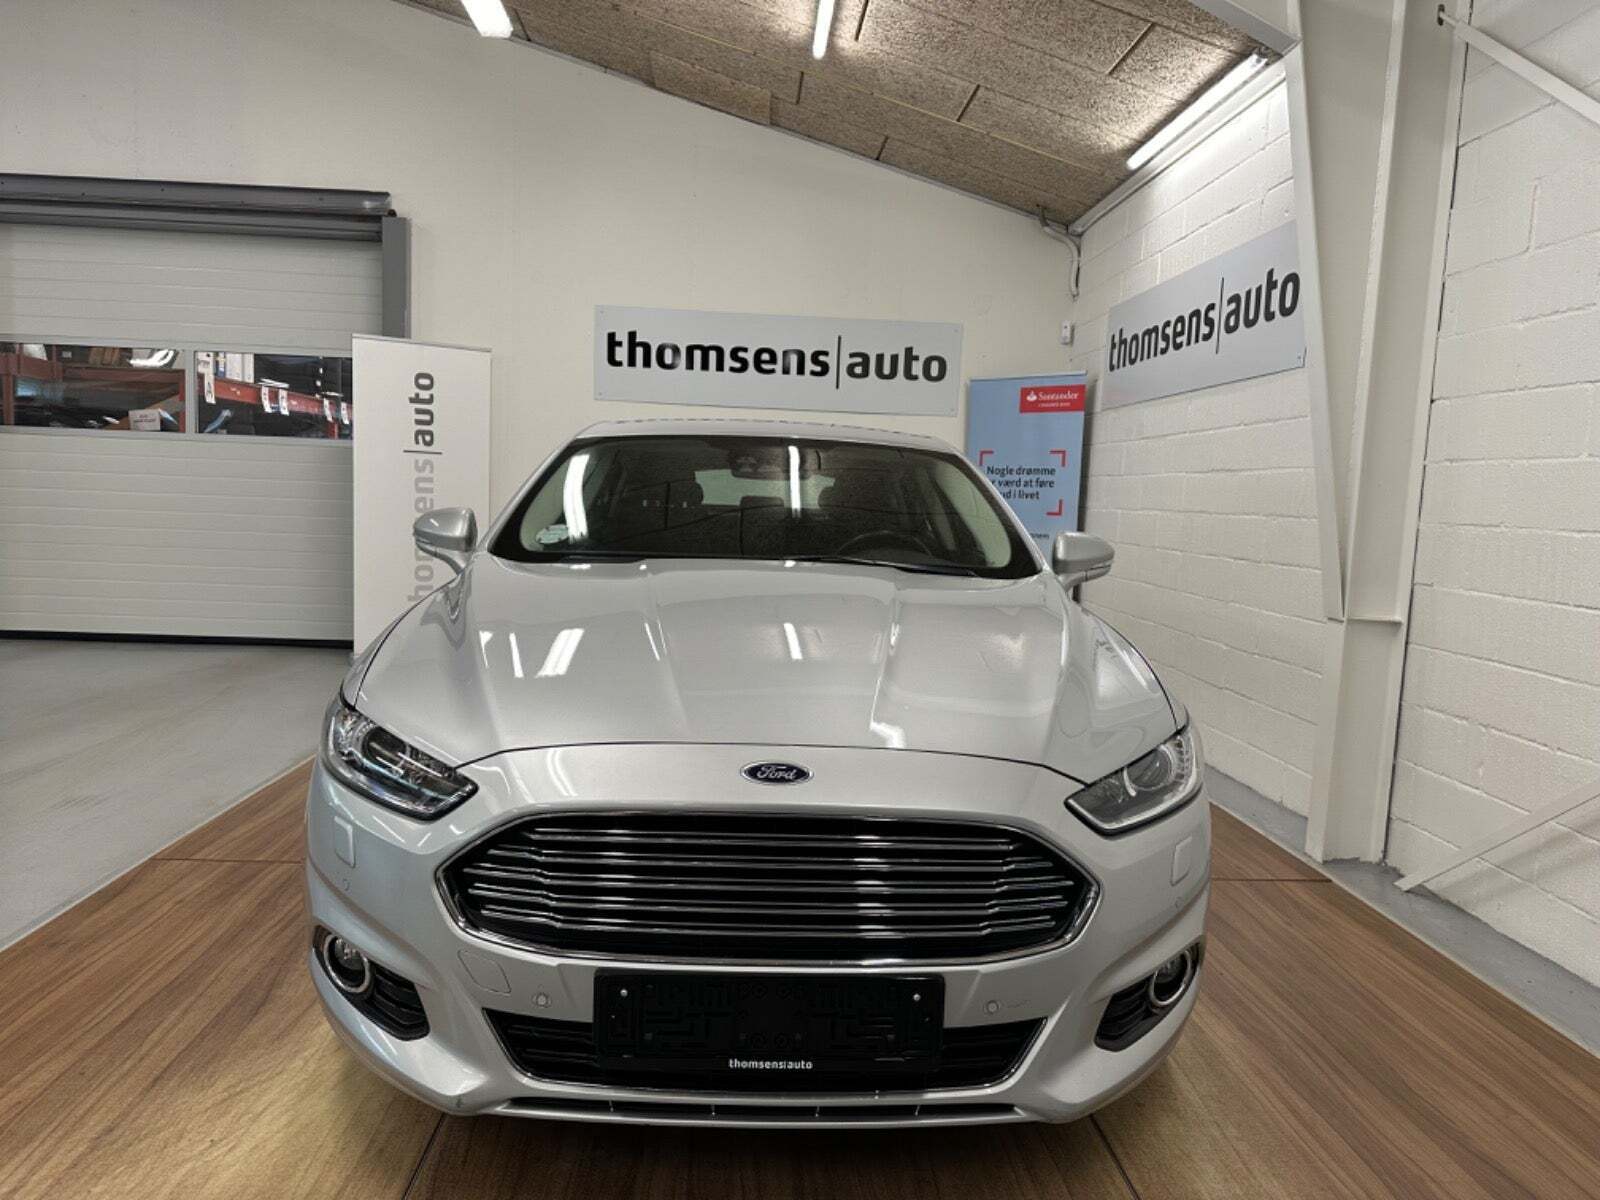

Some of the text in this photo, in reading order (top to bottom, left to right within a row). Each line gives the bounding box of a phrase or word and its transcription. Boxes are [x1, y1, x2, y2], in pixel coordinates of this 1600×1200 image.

[1038, 390, 1080, 401] Santander
[986, 465, 1056, 477] Nogle drømme
[998, 477, 1022, 488] værd
[1023, 479, 1033, 488] at
[1035, 477, 1055, 488] føre
[1018, 489, 1040, 500] livet
[756, 765, 797, 780] Ford
